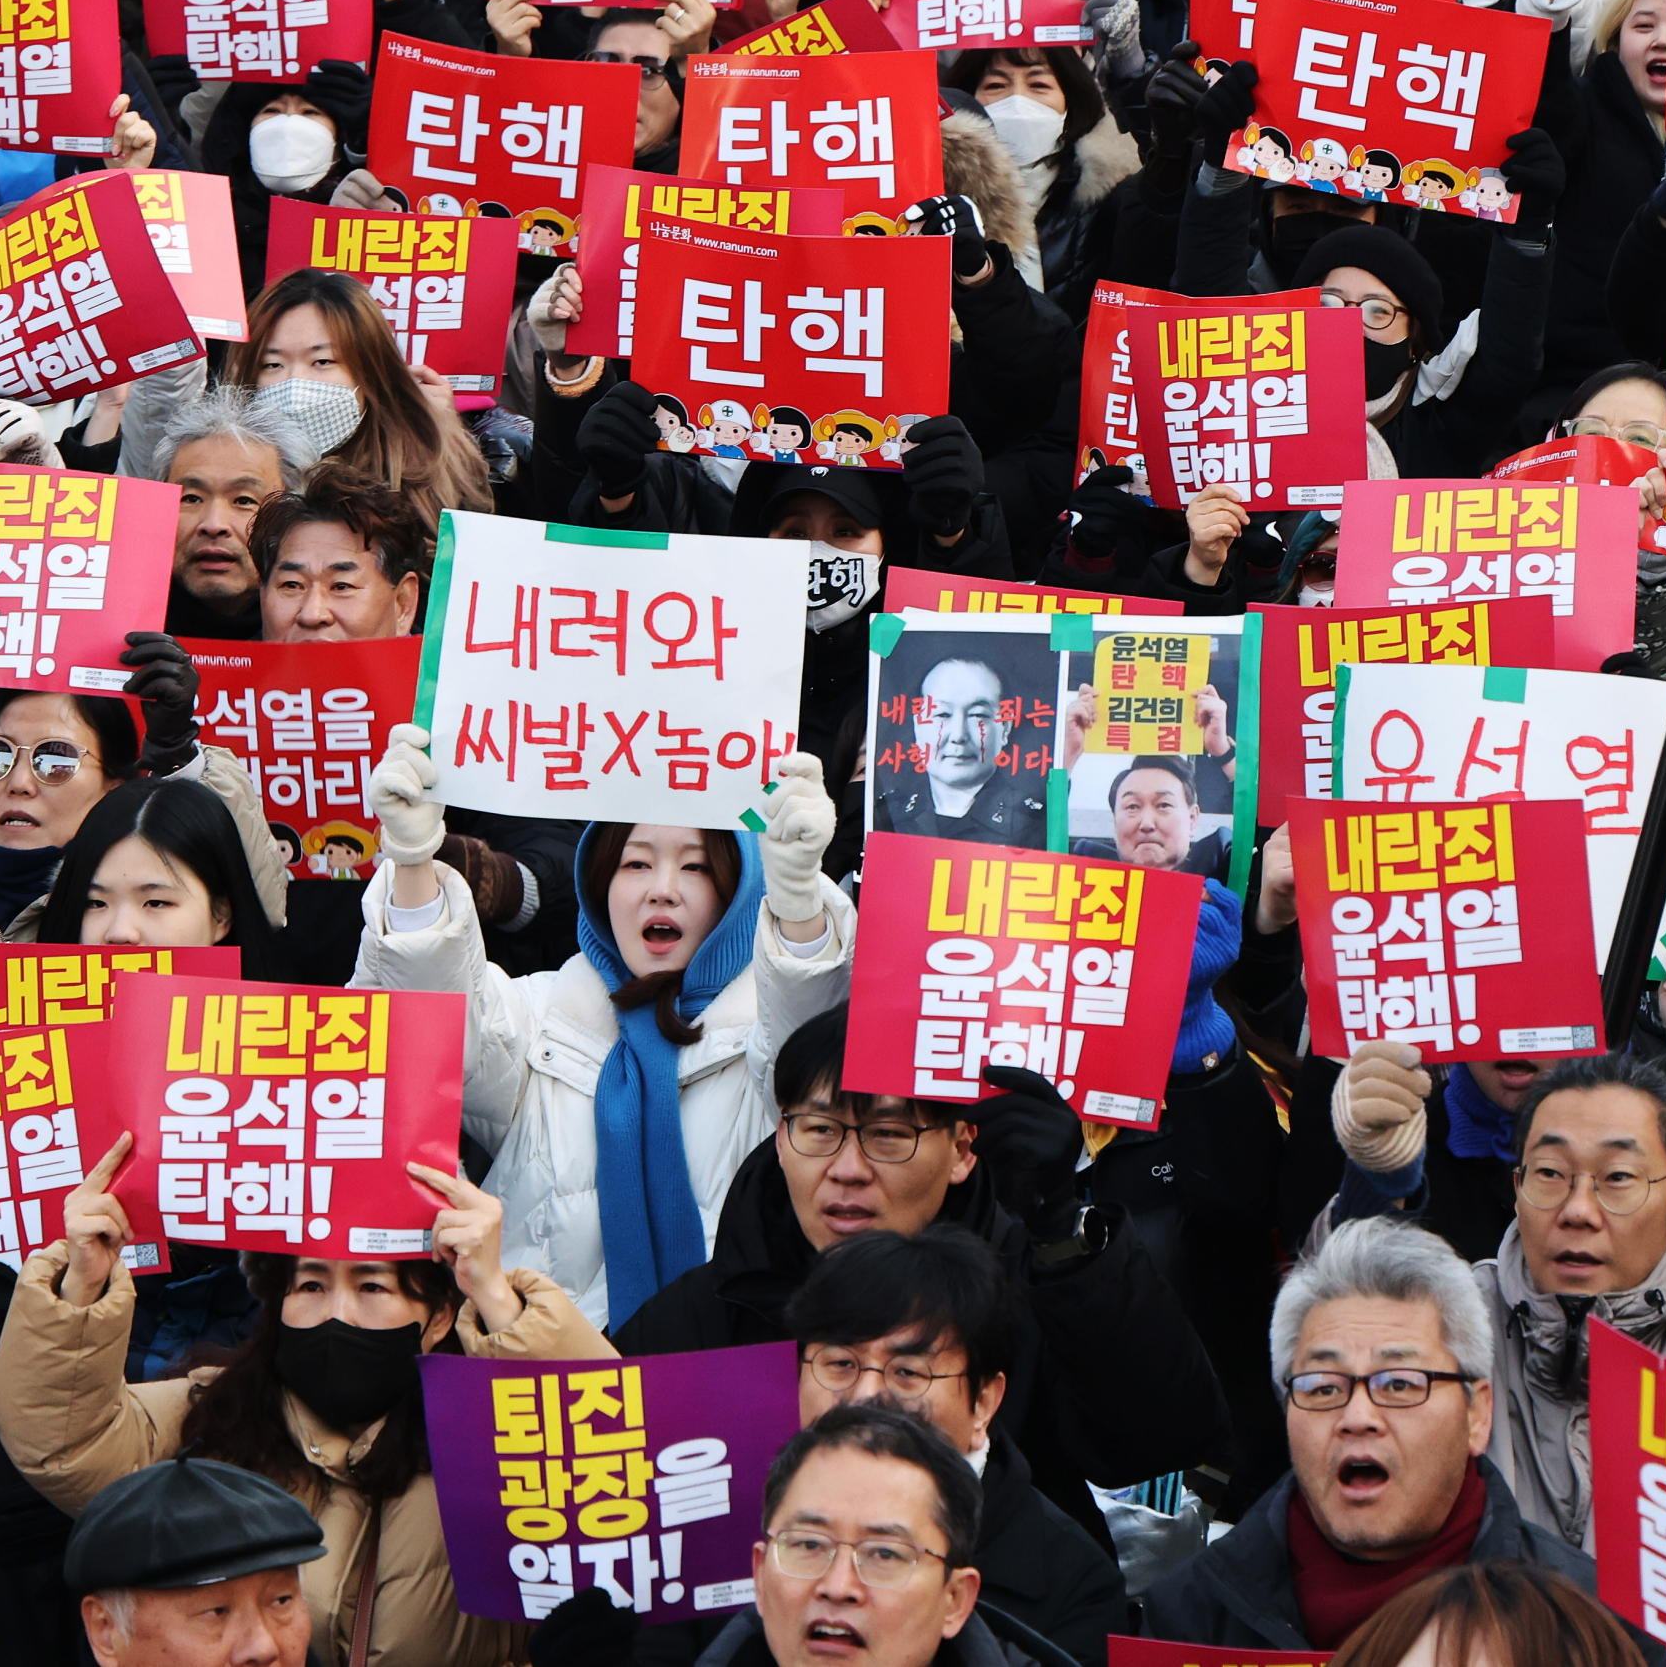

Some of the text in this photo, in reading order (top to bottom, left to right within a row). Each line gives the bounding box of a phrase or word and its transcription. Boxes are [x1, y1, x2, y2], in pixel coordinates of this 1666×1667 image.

[1292, 27, 1487, 152] 탄핵
[405, 91, 584, 199] 탄핵
[694, 236, 778, 258] www.nanum.com
[680, 279, 885, 397] 탄핵
[464, 581, 738, 681] 내려와
[1111, 636, 1188, 664] 윤석열
[879, 697, 1053, 728] 내란 죄는
[1107, 697, 1183, 725] 김건희
[995, 749, 1052, 776] 이다
[1323, 804, 1513, 894] 내란죄
[928, 858, 1144, 946] 내란죄
[1333, 887, 1522, 978] 윤석열
[919, 941, 1130, 1026] 윤석열
[1339, 973, 1479, 1052] 탄핵!
[166, 993, 389, 1076] 내란죄
[159, 1076, 384, 1159] 윤석열
[158, 1164, 331, 1244] 탄핵!
[492, 1365, 646, 1457] 퇴진
[499, 1437, 732, 1542] 광장을
[510, 1531, 683, 1621] 열자!
